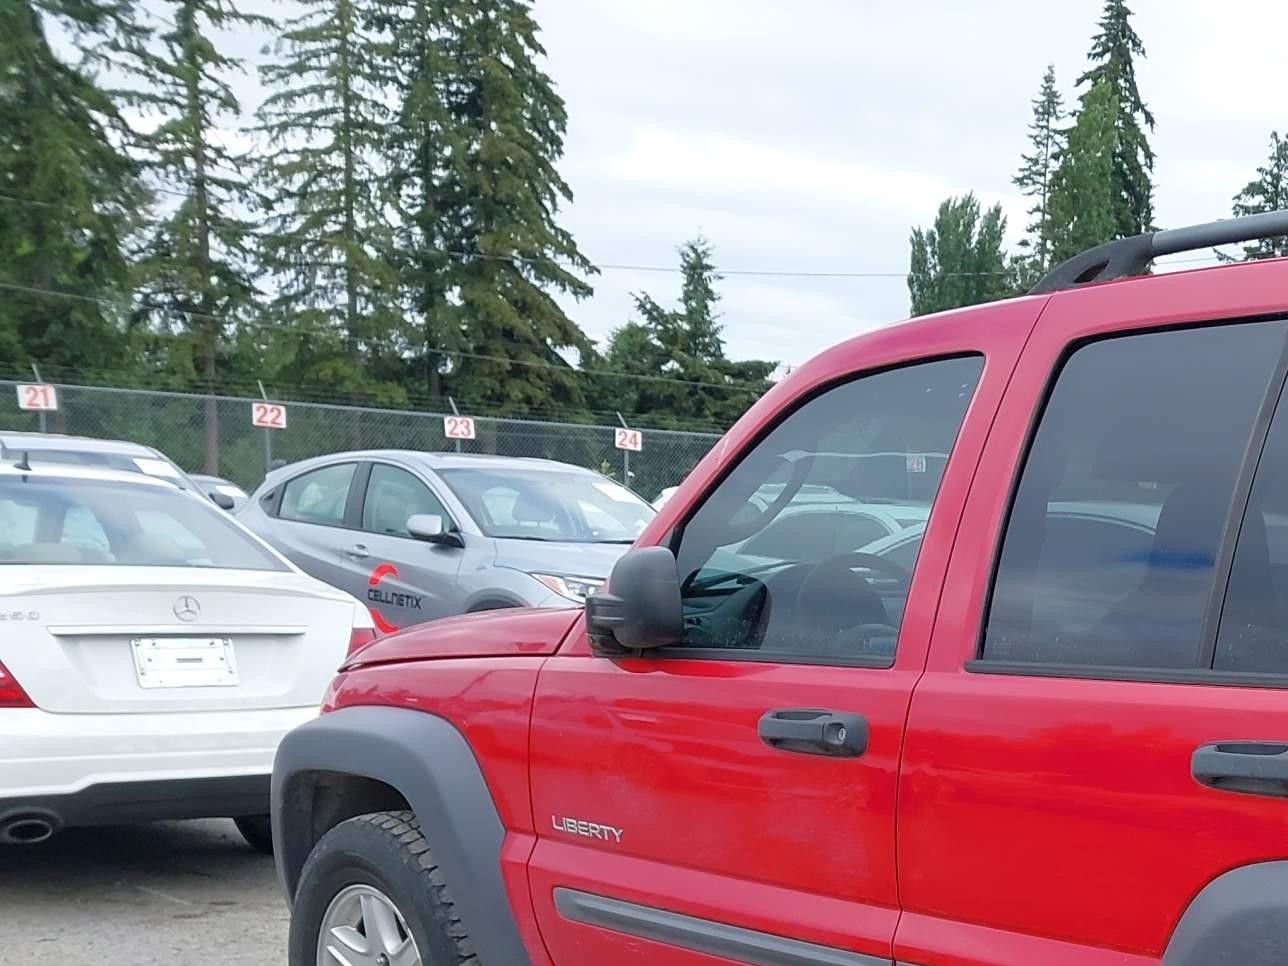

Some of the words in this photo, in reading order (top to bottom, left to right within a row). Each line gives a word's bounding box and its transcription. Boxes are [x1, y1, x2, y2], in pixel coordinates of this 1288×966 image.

[24, 386, 50, 407] 21
[256, 405, 283, 426] 22
[447, 419, 471, 437] 23
[618, 431, 640, 448] 24
[367, 588, 422, 610] CELLNETIX
[551, 815, 624, 844] LIBERTY
